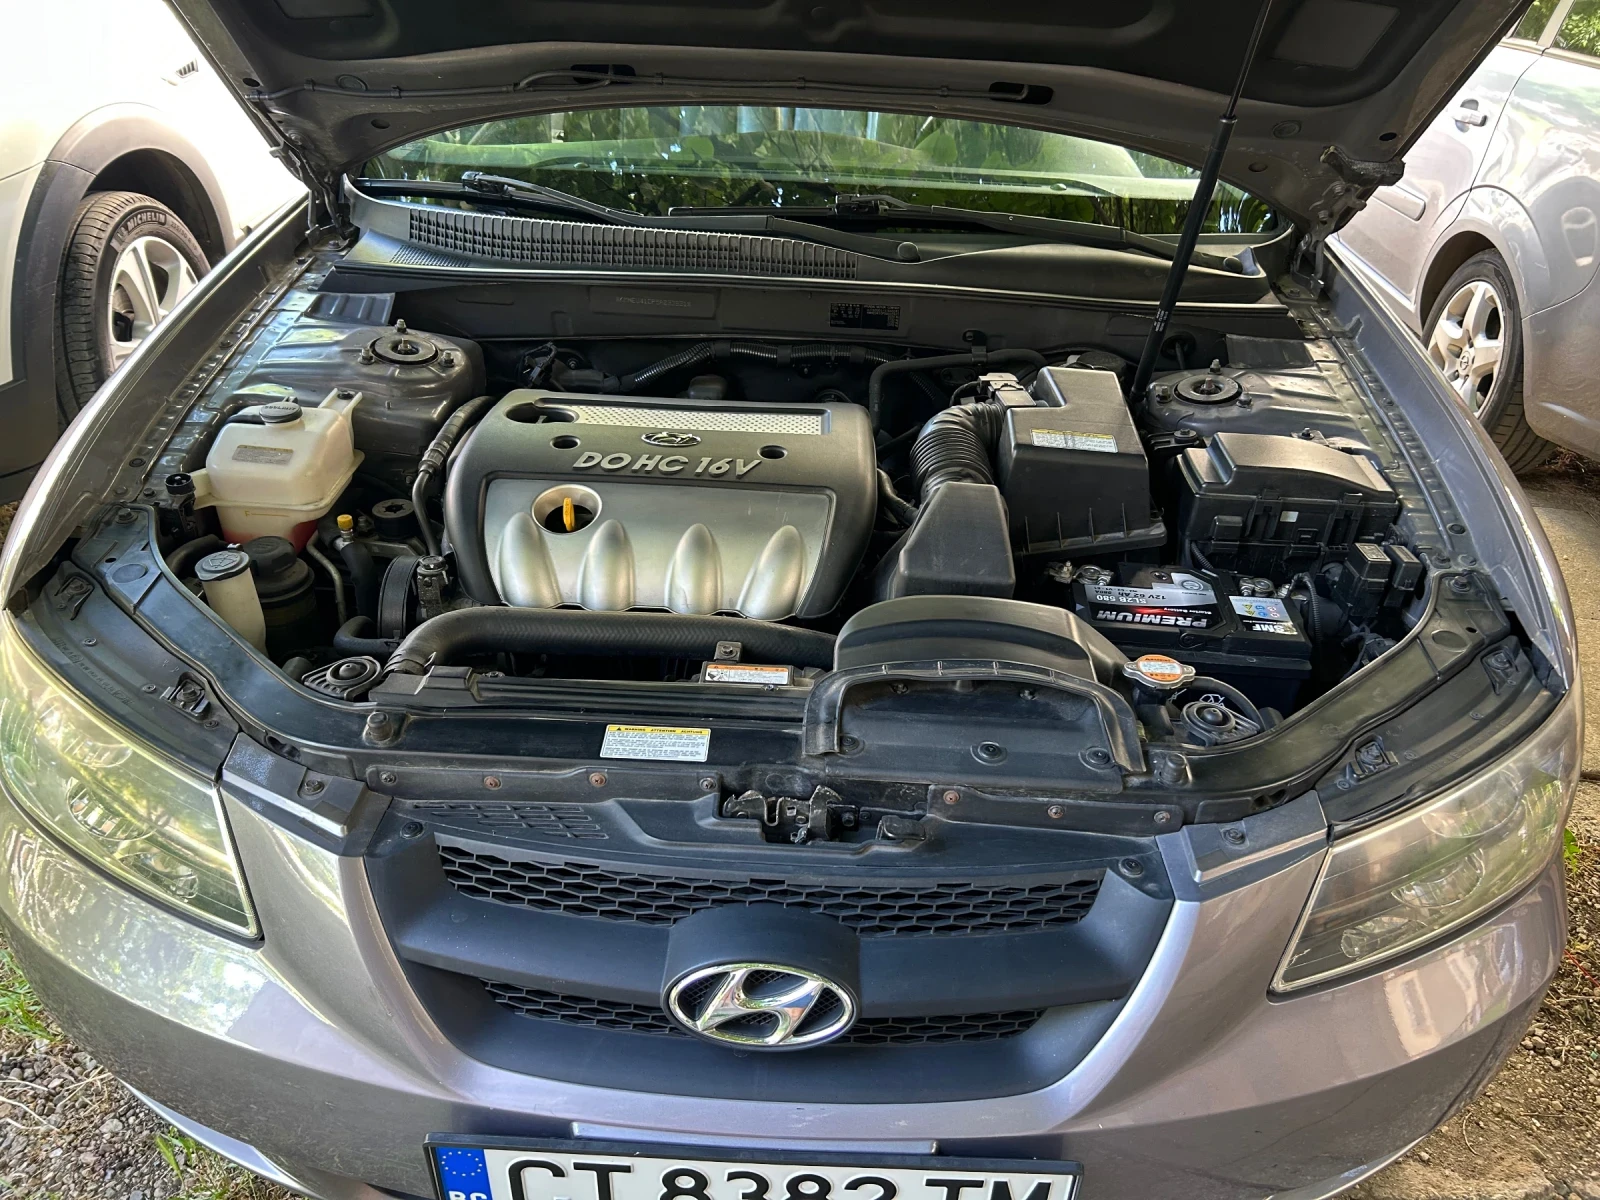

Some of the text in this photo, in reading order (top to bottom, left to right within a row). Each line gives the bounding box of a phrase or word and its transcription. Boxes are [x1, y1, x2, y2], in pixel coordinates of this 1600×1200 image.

[126, 212, 166, 231] MICHELIN
[573, 452, 762, 479] DOHC 16V
[1096, 594, 1116, 602] 580
[1096, 610, 1208, 628] PREMIUM
